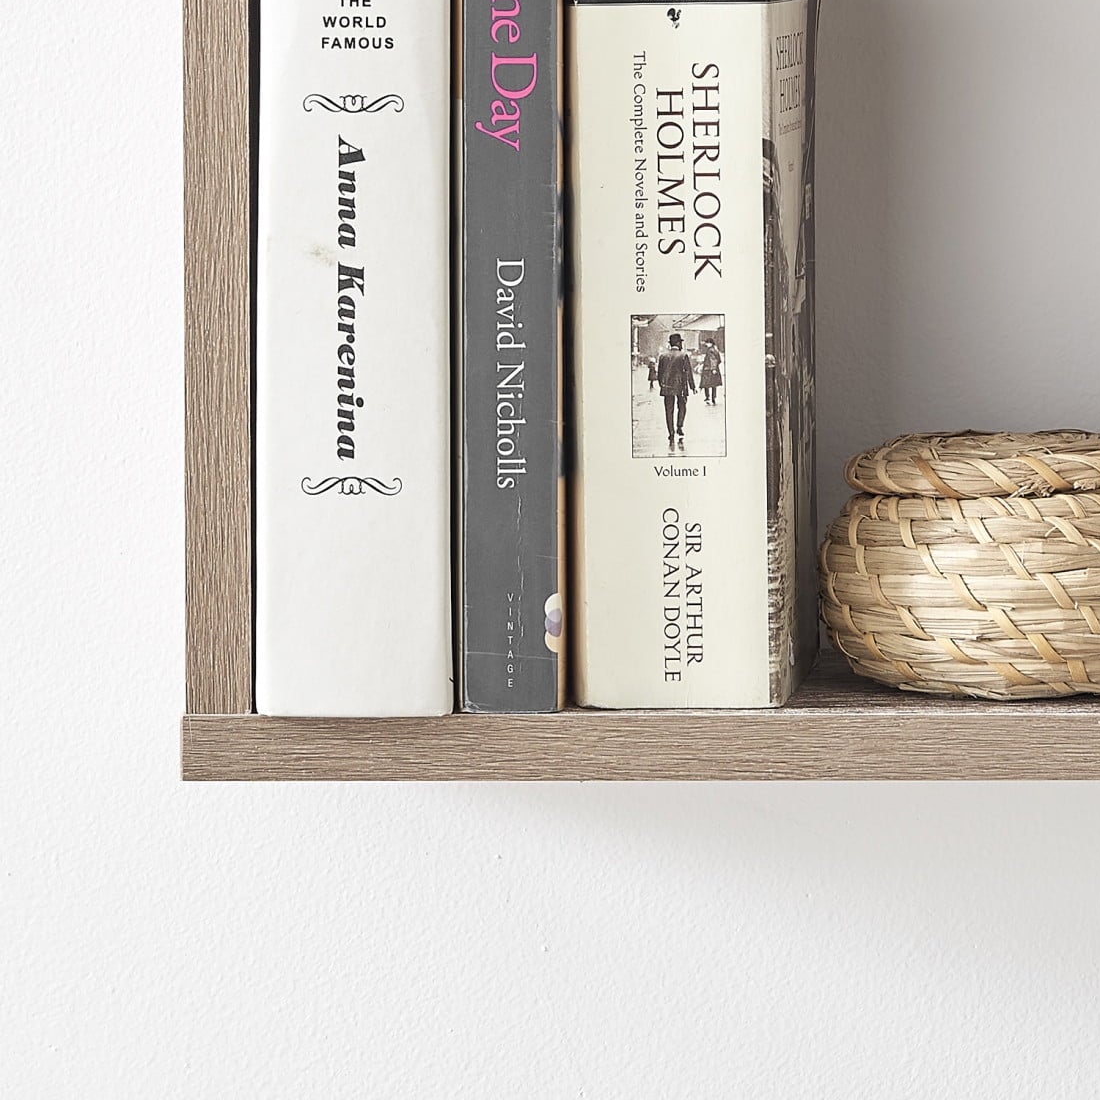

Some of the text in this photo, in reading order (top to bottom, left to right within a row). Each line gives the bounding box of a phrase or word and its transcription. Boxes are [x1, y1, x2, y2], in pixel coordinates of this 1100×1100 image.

[321, 36, 394, 50] FAMOUS
[322, 15, 387, 29] WORLD
[475, 52, 537, 152] Day
[629, 50, 649, 293] The Complete Novels and Stories
[655, 87, 686, 255] HOLMES
[691, 62, 722, 281] SHERLOCK
[336, 134, 366, 461] Anna Karenina
[496, 257, 527, 489] David Nicholls
[653, 464, 699, 477] Volume
[506, 592, 514, 688] VINTAGE
[662, 507, 682, 682] CONAN DOYLE
[684, 522, 704, 667] SIR ARTHUR
